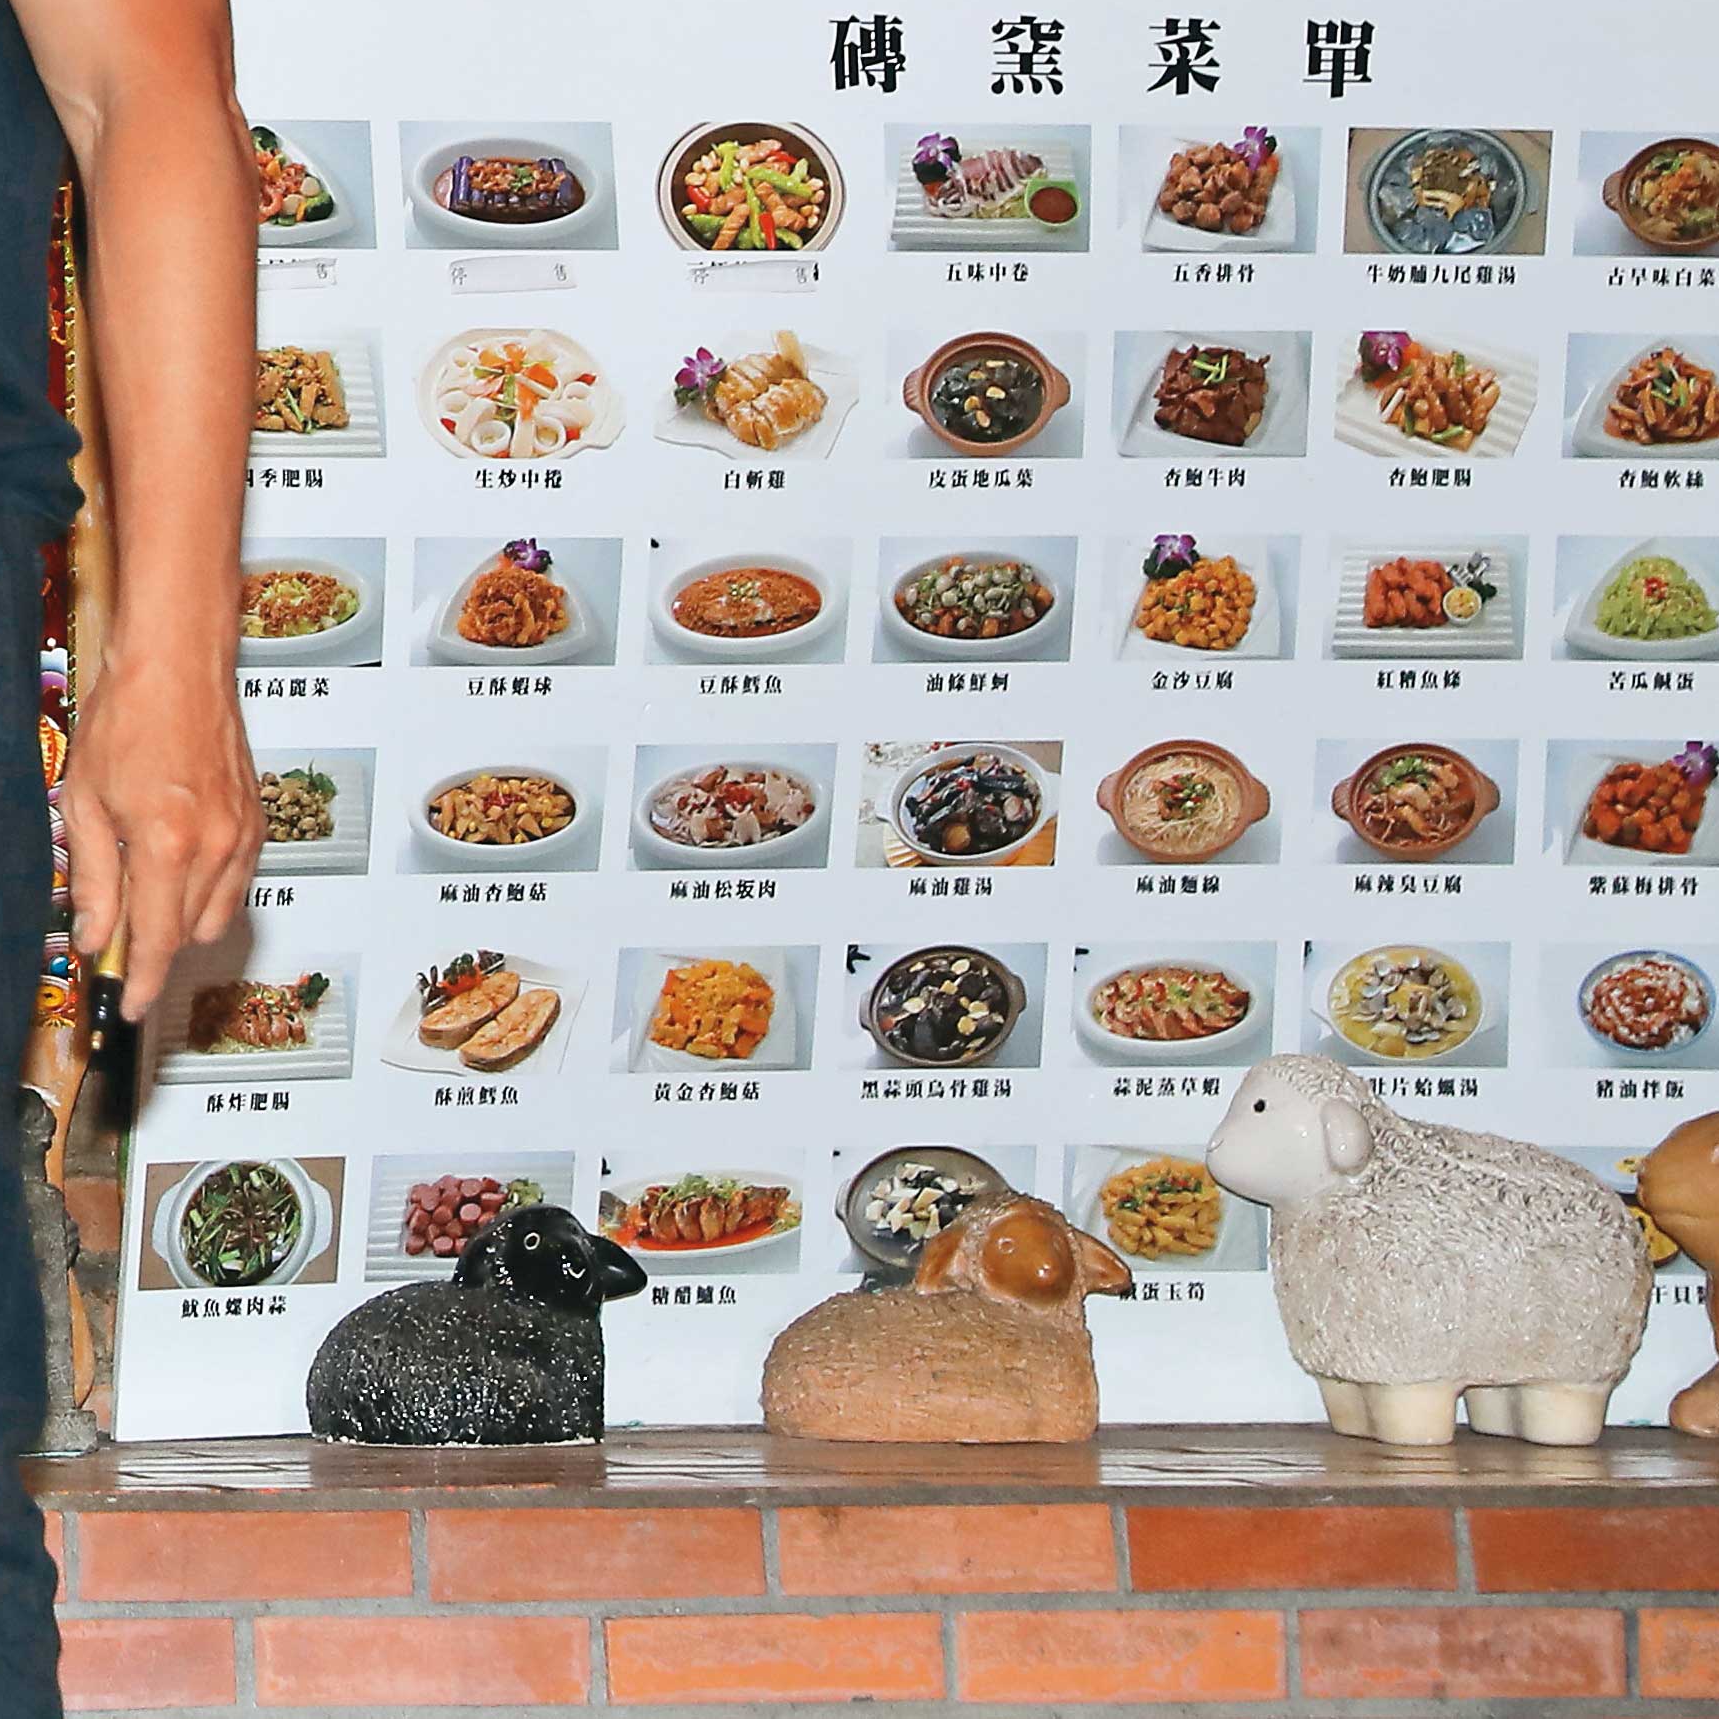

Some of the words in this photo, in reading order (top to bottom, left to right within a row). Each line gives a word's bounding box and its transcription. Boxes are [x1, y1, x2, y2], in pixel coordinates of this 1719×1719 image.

[829, 14, 1375, 98] 磚窯菜單
[947, 262, 1028, 282] 五味中卷
[1175, 263, 1254, 283] 五香排骨
[1609, 267, 1714, 287] 古早味白菜
[724, 470, 785, 489] 白斬雞
[929, 468, 1033, 488] 皮蛋地瓜葉
[1165, 468, 1245, 487] 杏鮑牛肉
[1389, 468, 1471, 487] 杏鮑肥腸
[1620, 469, 1703, 489] 杏鮑軟絲
[237, 677, 330, 698] 酥高麗菜
[467, 676, 552, 696] 豆酥蝦球
[700, 675, 781, 694] 豆酥鱈魚
[927, 673, 1009, 692] 油條鮮蚵
[1152, 671, 1233, 690] 金沙豆腐
[1610, 671, 1694, 691] 苦瓜鹹蛋
[440, 882, 547, 902] 麻油杏鮑菇
[909, 877, 992, 896] 麻油雞湯
[1136, 875, 1219, 894] 麻油麵線
[1355, 874, 1461, 894] 麻辣臭豆腐
[244, 886, 295, 907] 仔酥
[435, 1086, 518, 1106] 酥煎鱈魚
[655, 1081, 759, 1102] 黃金杏鮑菇
[861, 1079, 1011, 1099] 黑蒜頭烏骨雞湯
[1114, 1077, 1219, 1096] 蒜泥蒸草蝦
[1597, 1079, 1683, 1099] 豬油拌飯
[207, 1092, 289, 1113] 酥炸肥腸
[652, 1285, 736, 1305] 糖醋鱸魚
[181, 1295, 286, 1318] 魷魚螺肉蒜
